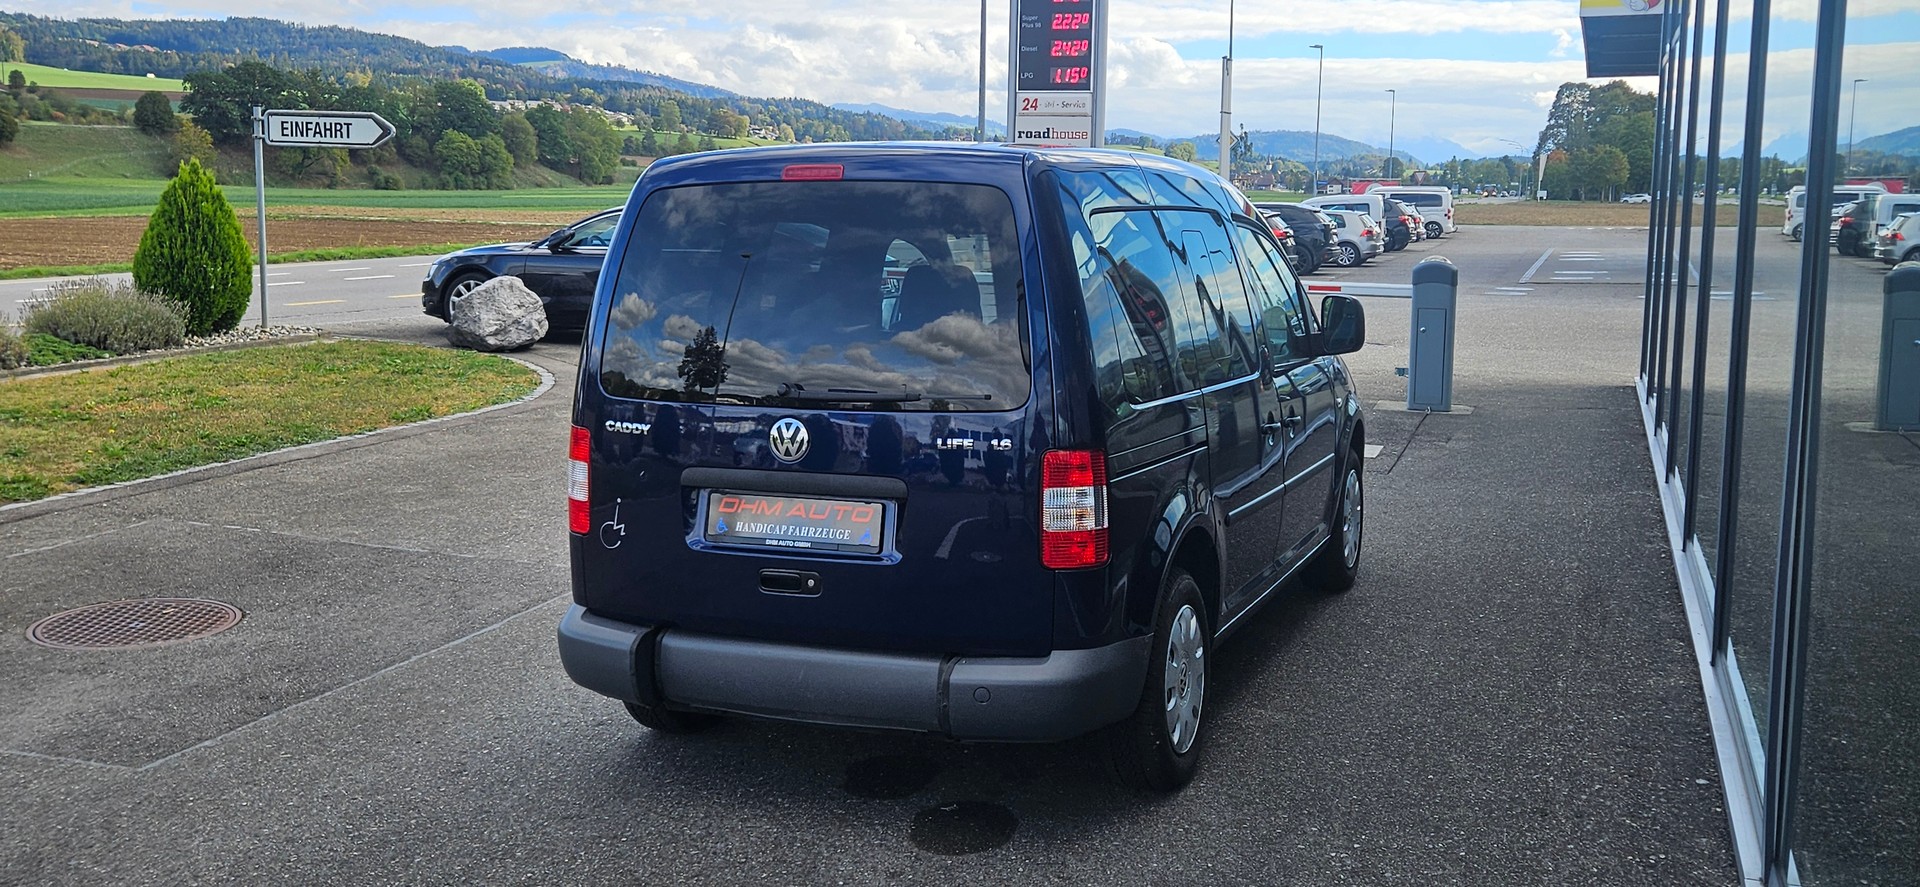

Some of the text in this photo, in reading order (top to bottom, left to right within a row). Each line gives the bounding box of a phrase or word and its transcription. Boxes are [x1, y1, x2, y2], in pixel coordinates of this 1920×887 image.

[1021, 97, 1039, 111] 24
[280, 120, 353, 139] EINFAHRT
[1017, 127, 1088, 140] roadhouse
[605, 419, 652, 435] CADDY
[936, 438, 1012, 451] LIFE 1.6
[718, 497, 875, 523] DHM AUTO
[735, 521, 852, 540] HANDICAP FAHRZEUGE
